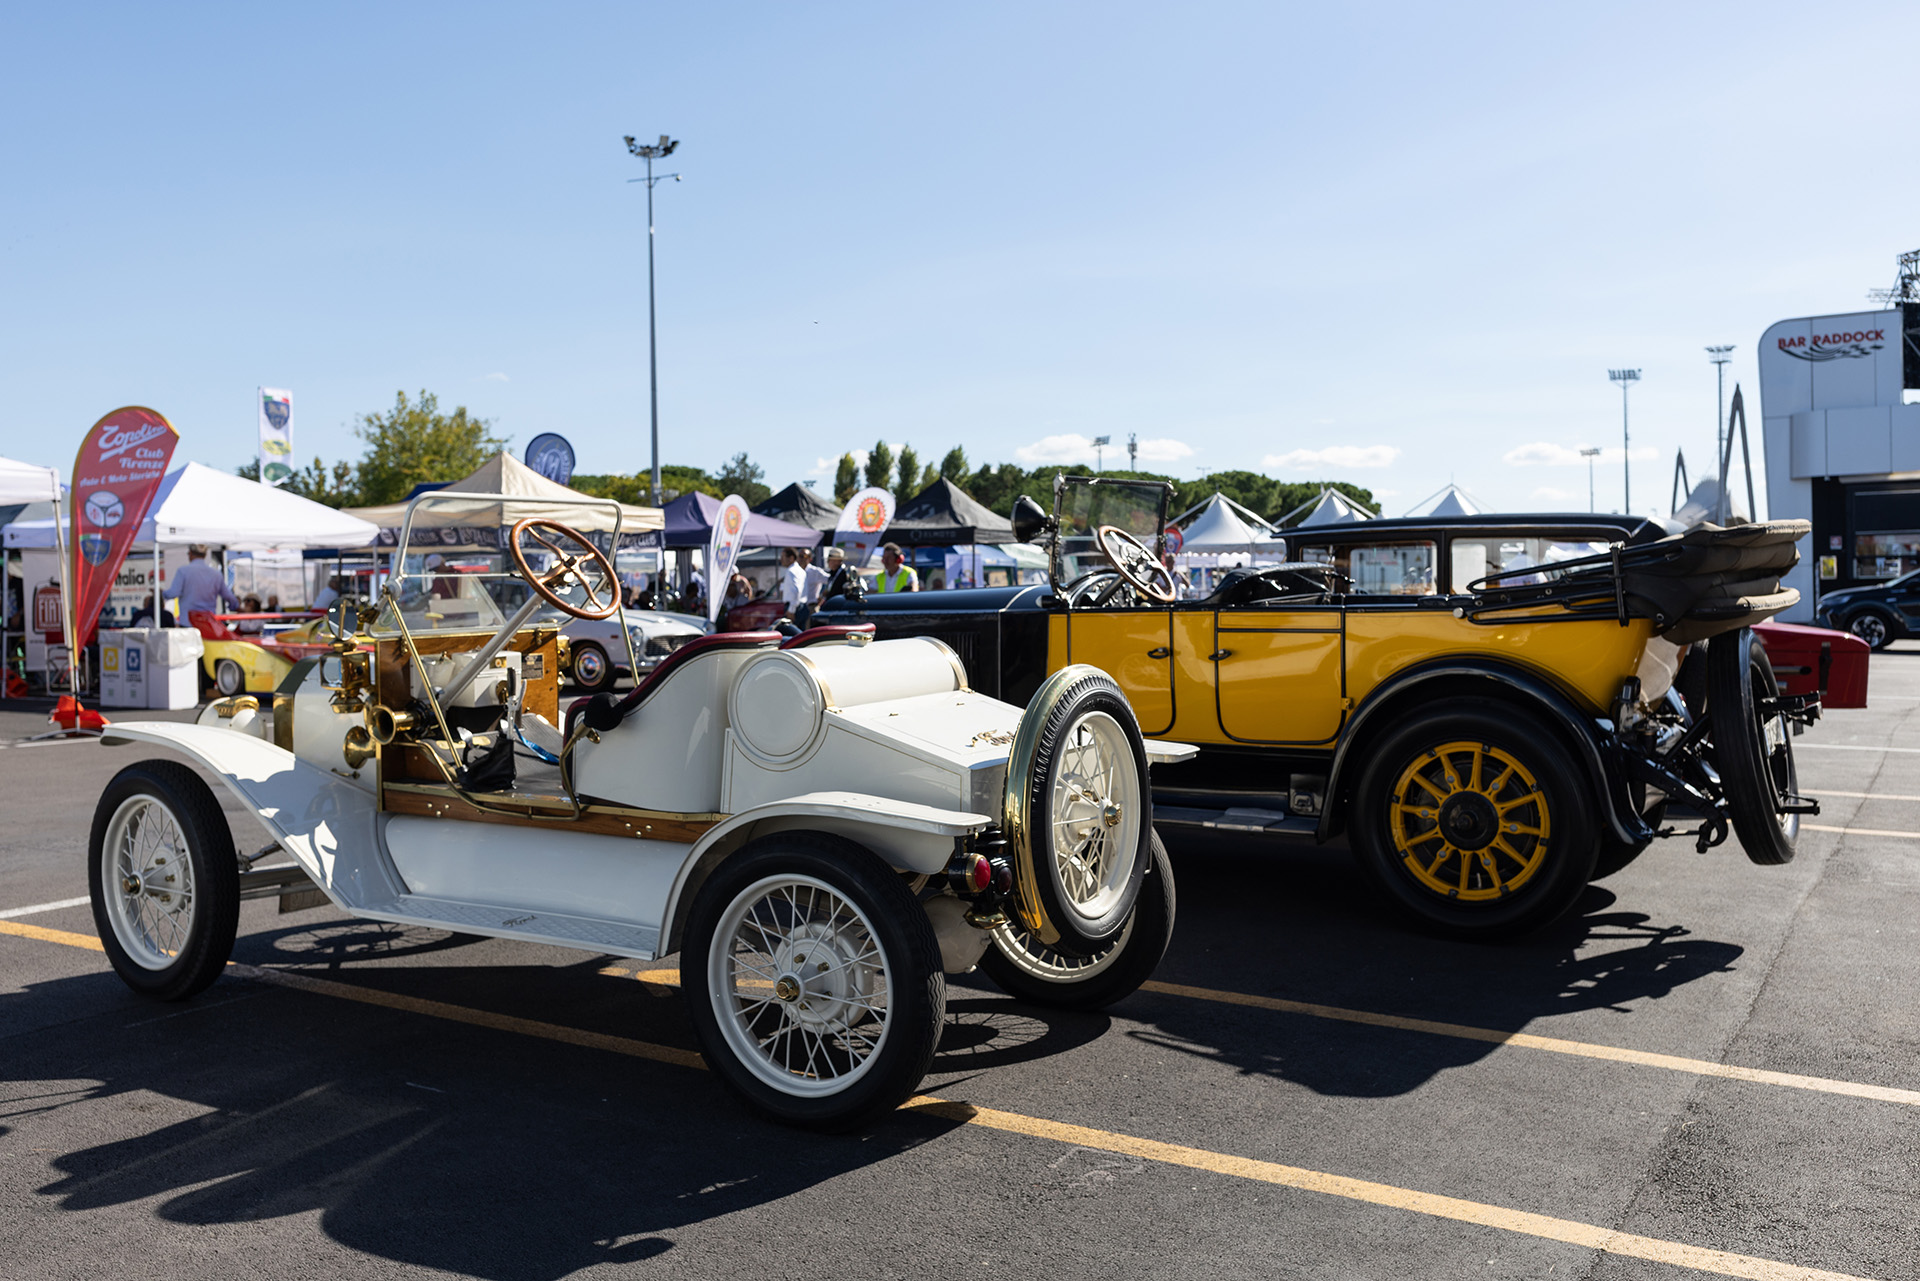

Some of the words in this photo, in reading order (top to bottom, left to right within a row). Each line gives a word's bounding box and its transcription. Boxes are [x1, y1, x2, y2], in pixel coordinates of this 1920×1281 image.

[1778, 336, 1806, 349] BAR
[1812, 329, 1884, 345] PADDOCK
[136, 448, 164, 458] Club
[119, 457, 165, 469] Firenze
